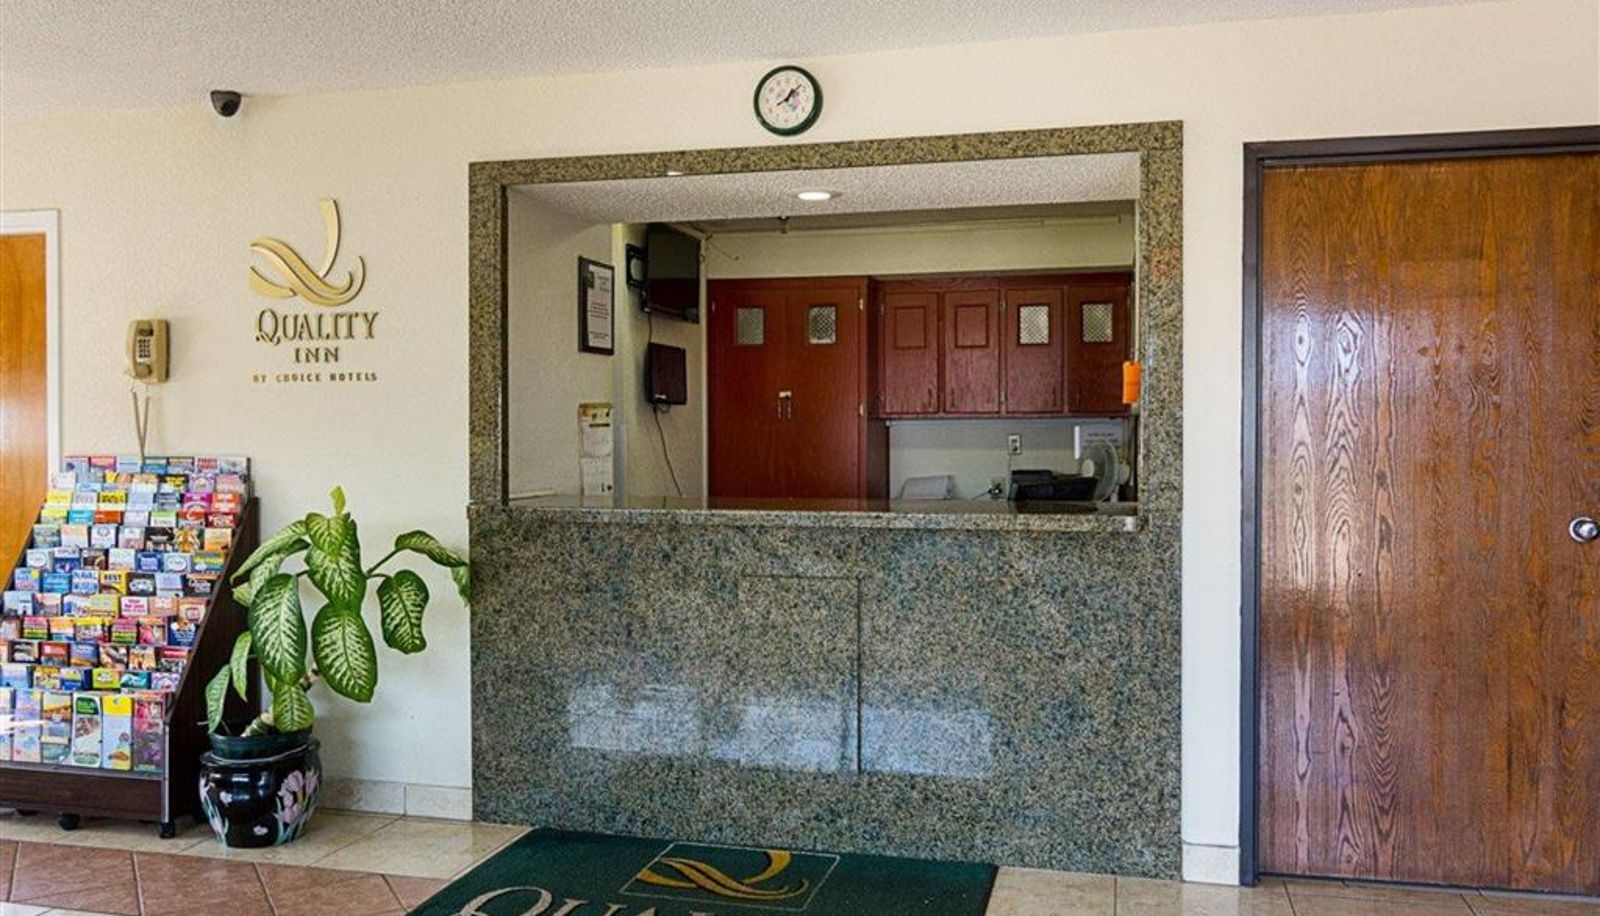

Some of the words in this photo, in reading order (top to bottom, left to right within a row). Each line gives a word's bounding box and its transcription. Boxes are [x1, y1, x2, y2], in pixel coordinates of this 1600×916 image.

[255, 308, 379, 345] QUALITY
[294, 347, 339, 363] INN
[329, 372, 378, 382] HOTELS
